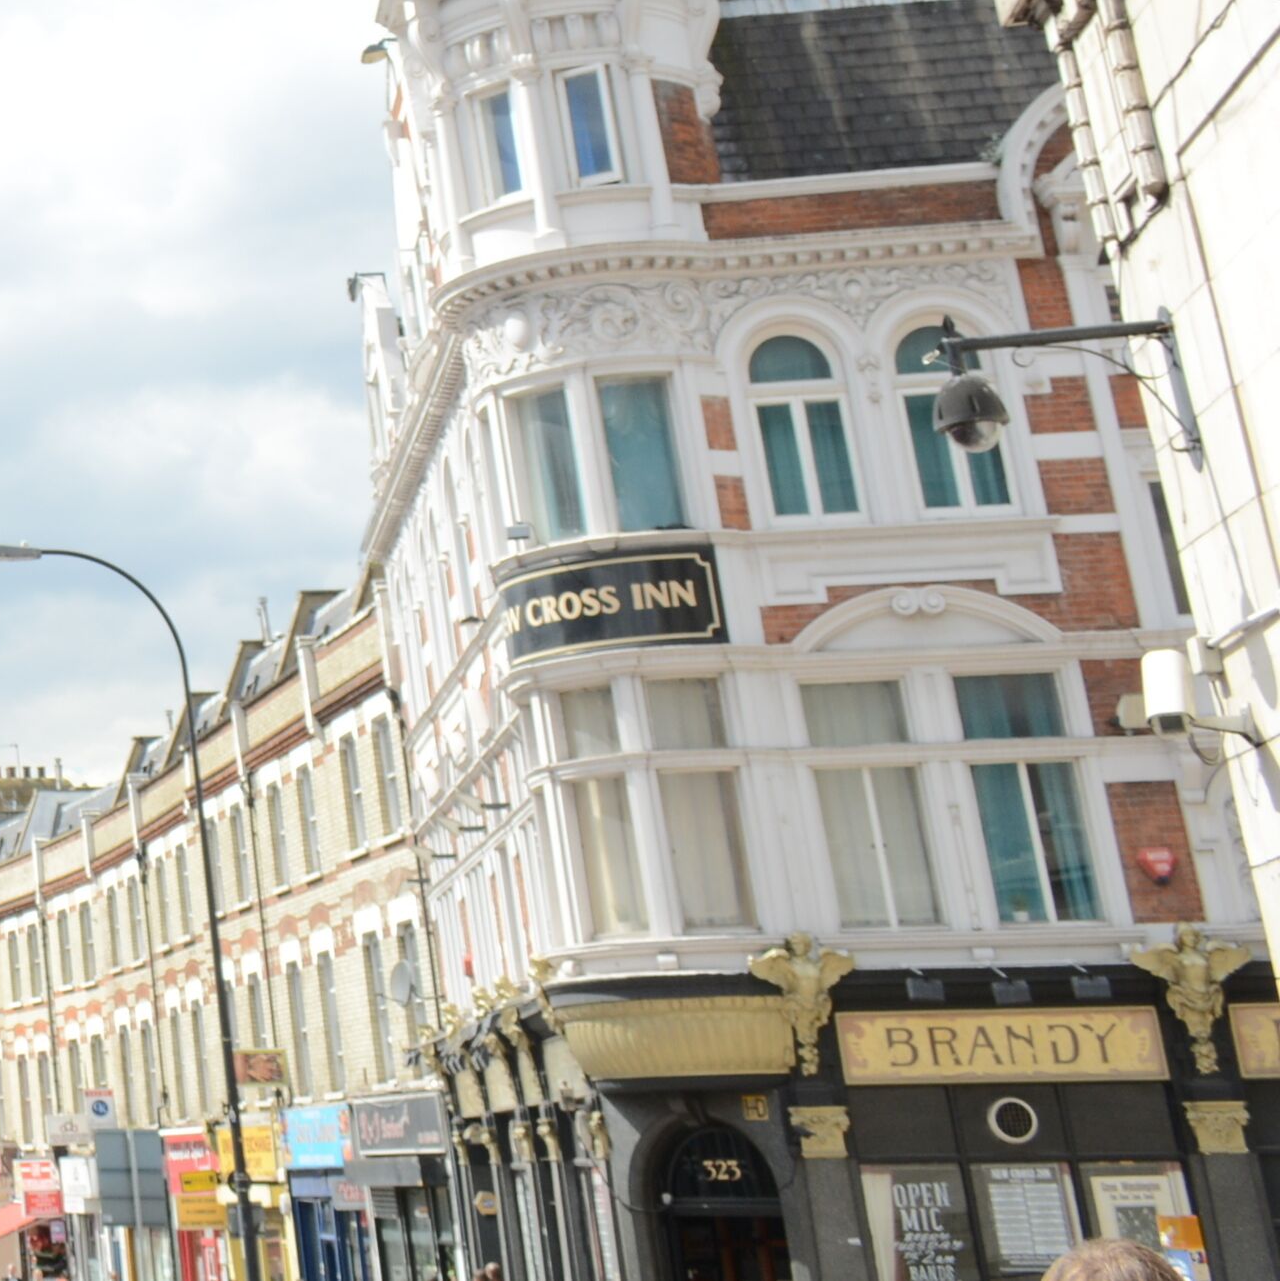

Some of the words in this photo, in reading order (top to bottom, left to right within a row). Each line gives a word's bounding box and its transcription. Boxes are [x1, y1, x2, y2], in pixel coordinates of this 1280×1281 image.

[525, 585, 621, 627] CROSS
[630, 579, 698, 611] INN
[885, 1022, 1117, 1067] BRANDY
[702, 1159, 741, 1181] 323
[893, 1182, 951, 1208] OPEN
[899, 1207, 944, 1232] MIC
